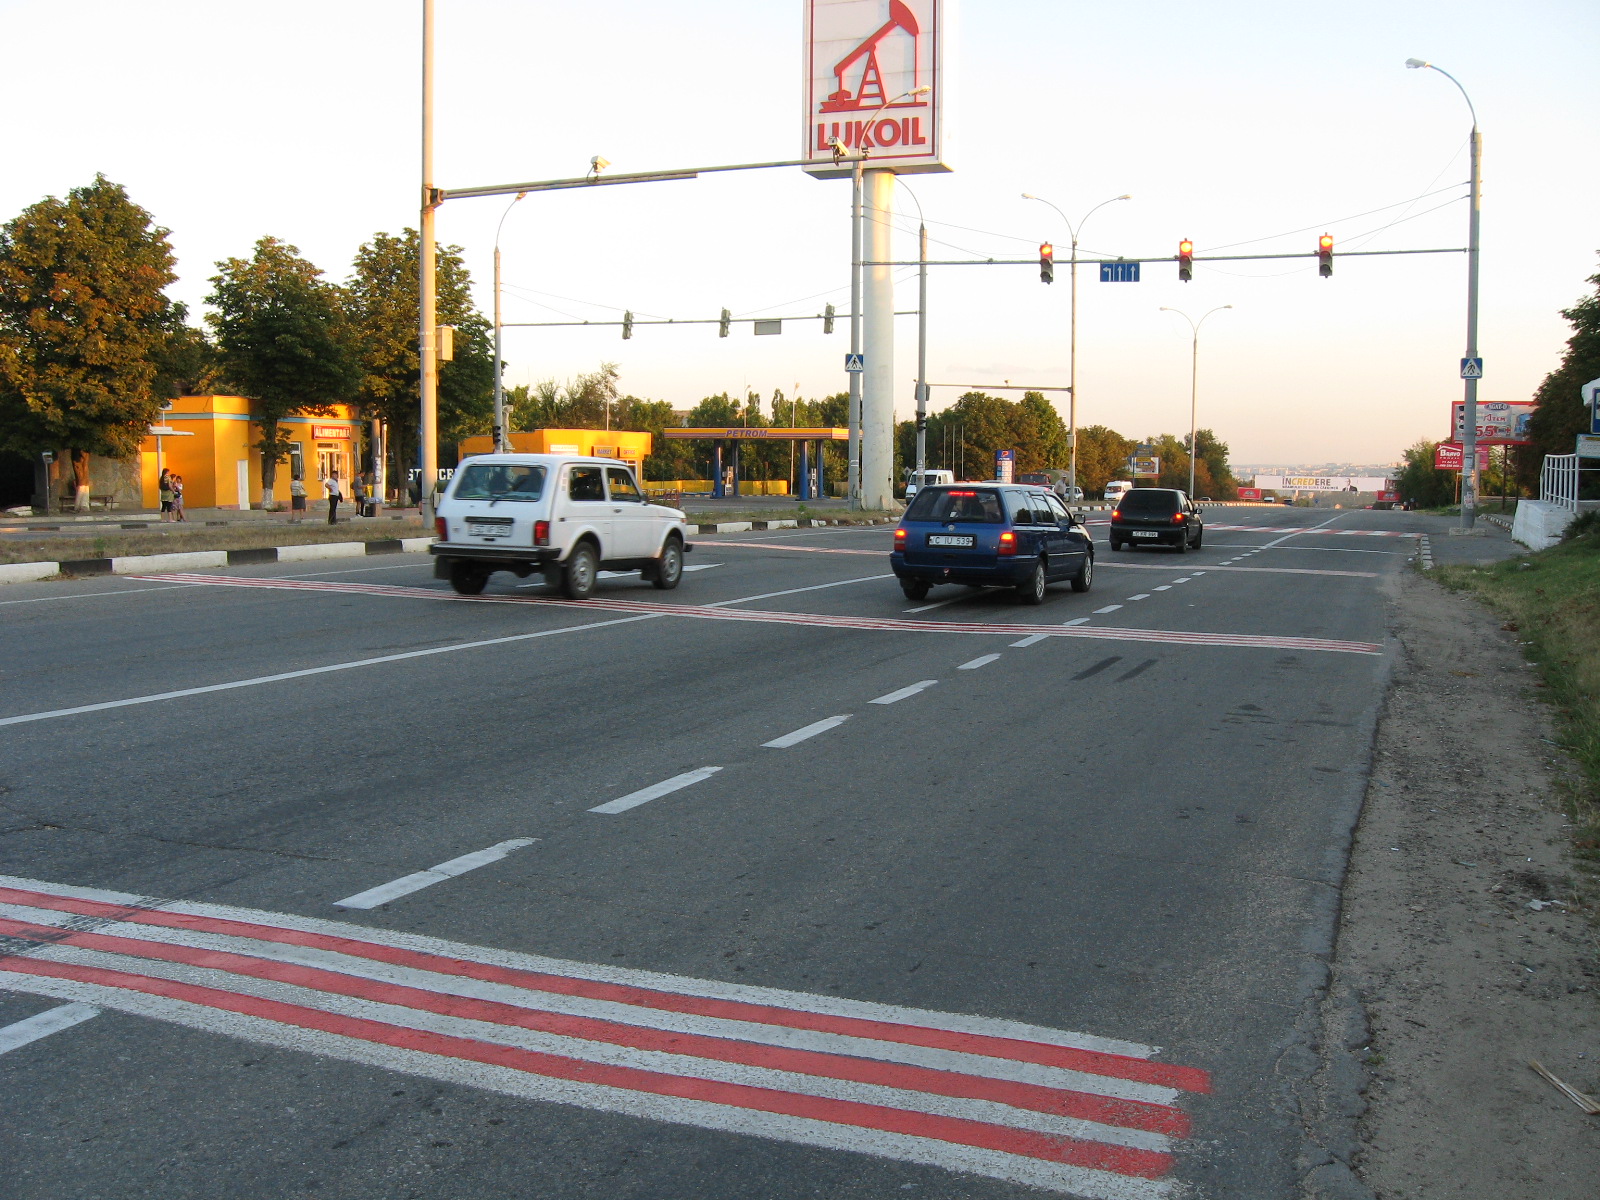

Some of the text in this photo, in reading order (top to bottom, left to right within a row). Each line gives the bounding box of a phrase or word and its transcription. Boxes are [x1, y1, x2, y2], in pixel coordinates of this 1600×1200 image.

[818, 117, 926, 150] LUKOIL
[726, 429, 768, 437] PETROM
[956, 537, 970, 545] 539
